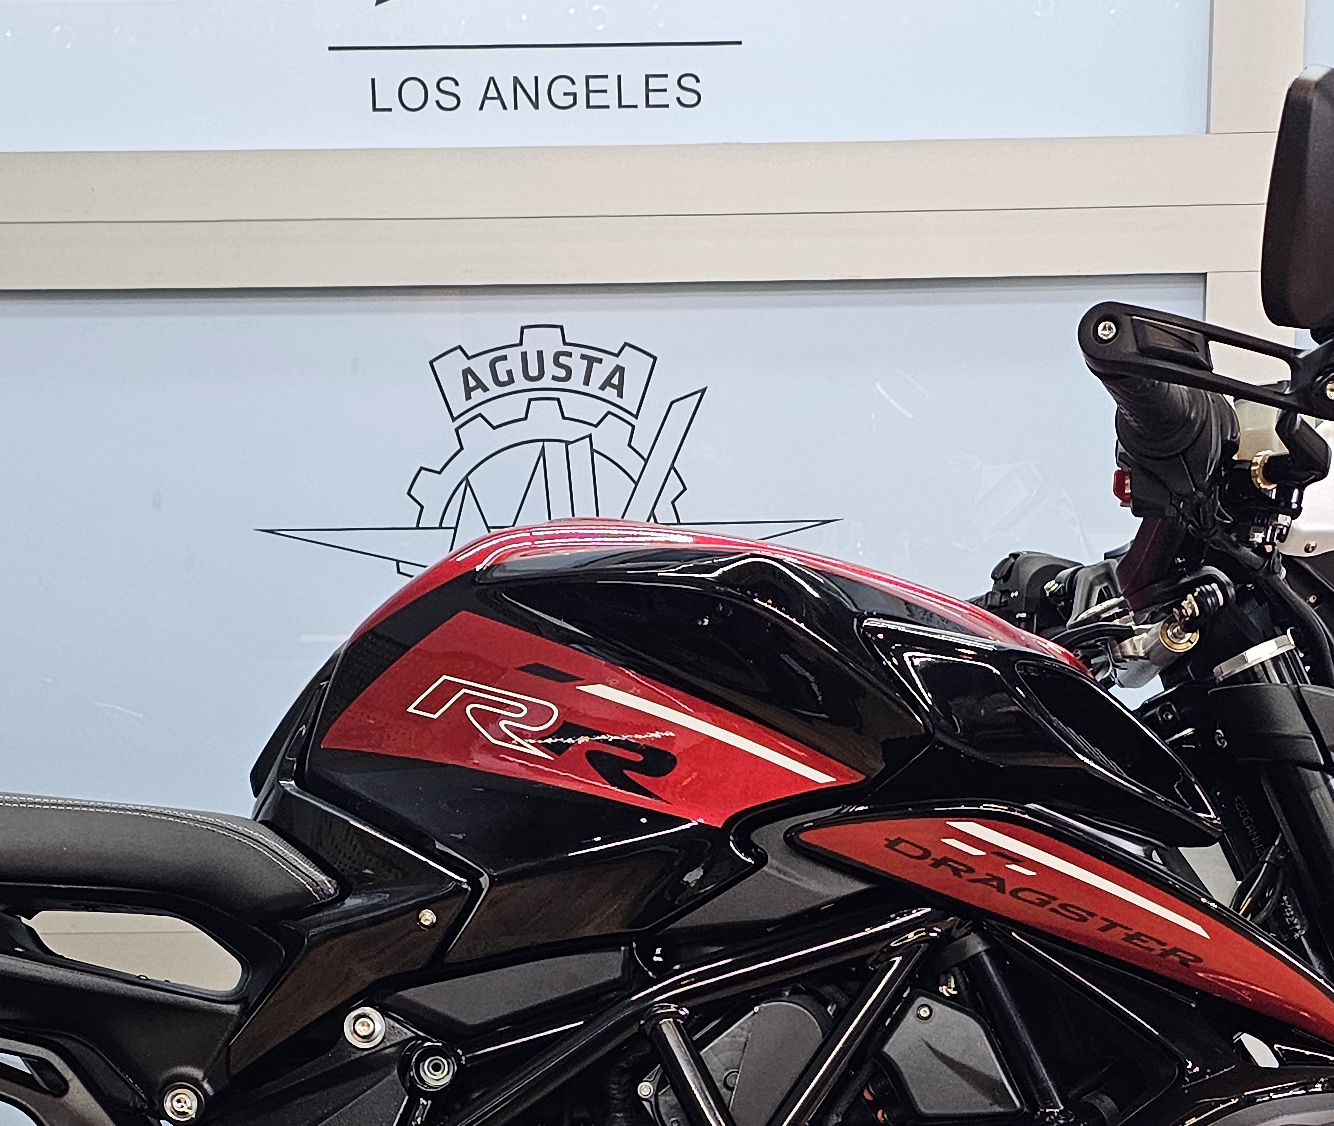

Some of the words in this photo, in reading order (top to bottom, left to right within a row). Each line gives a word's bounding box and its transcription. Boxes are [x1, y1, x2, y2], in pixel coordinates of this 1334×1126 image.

[371, 76, 460, 112] LOS
[479, 73, 701, 110] ANGELES
[462, 350, 626, 401] AGUSTA
[883, 836, 1204, 969] DRAGSTER
